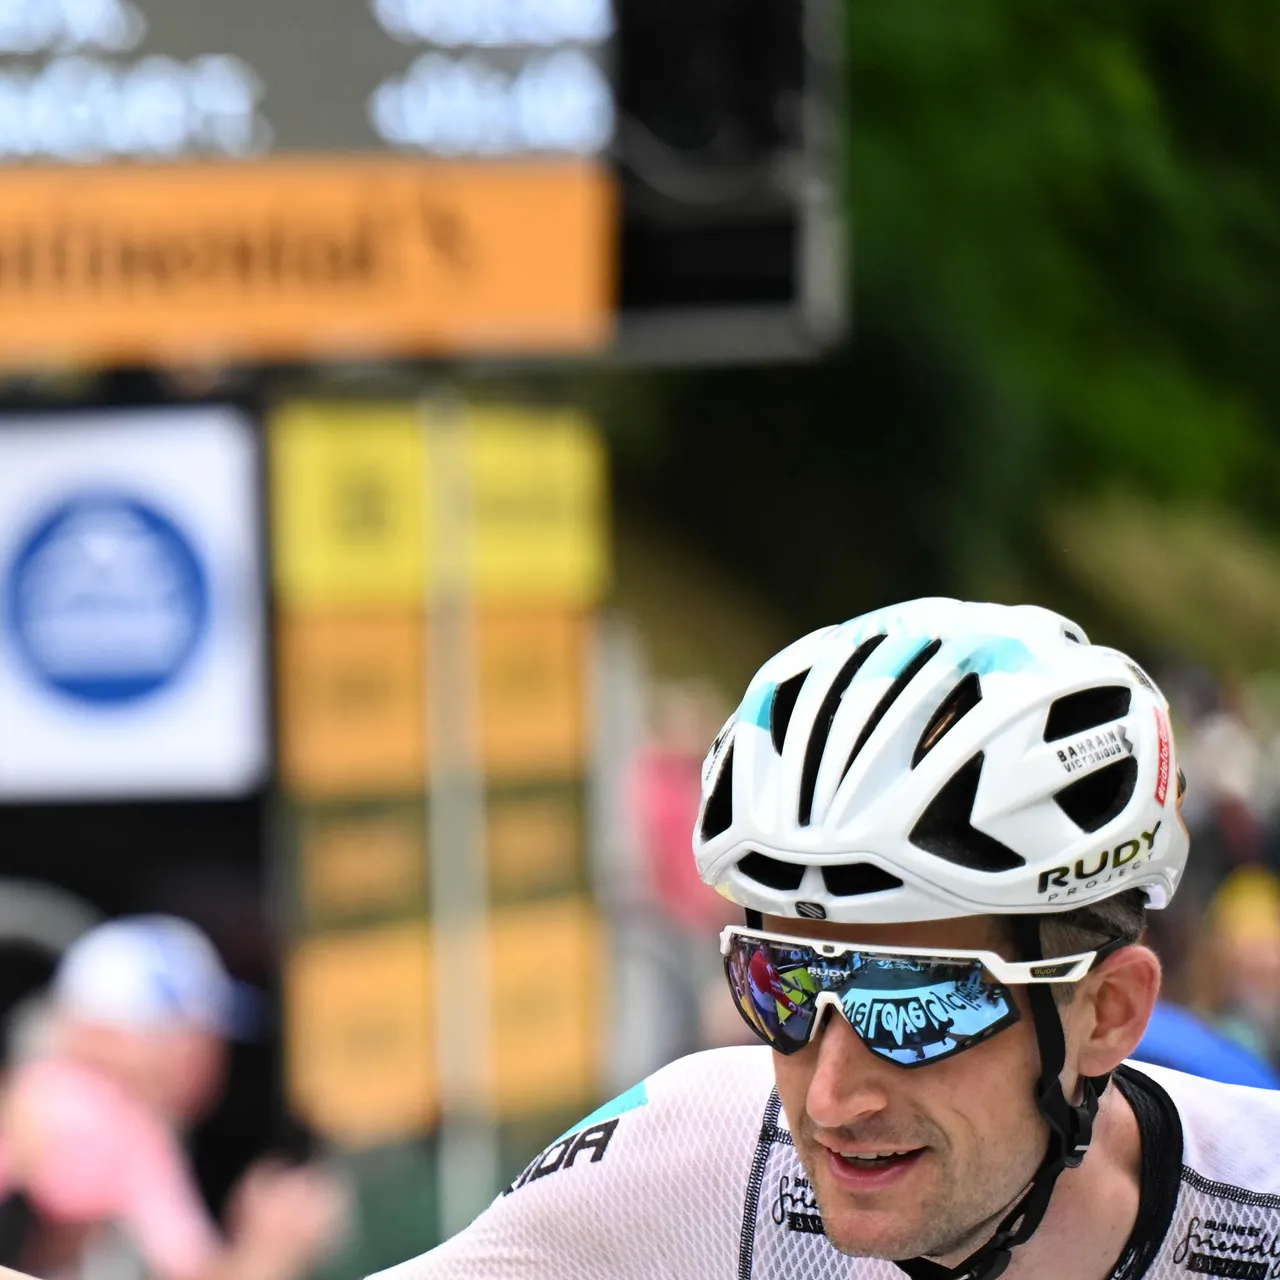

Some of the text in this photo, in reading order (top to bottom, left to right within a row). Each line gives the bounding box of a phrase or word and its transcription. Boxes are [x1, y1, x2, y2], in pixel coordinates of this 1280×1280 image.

[1056, 730, 1118, 763] BAHRAIN
[1062, 743, 1122, 773] VICTORIOUS
[1037, 820, 1162, 895] RUDY
[1047, 853, 1153, 902] PROJECT
[807, 967, 851, 978] RUDY
[503, 1118, 620, 1197] IDA
[1205, 1219, 1262, 1238] BUSINESS
